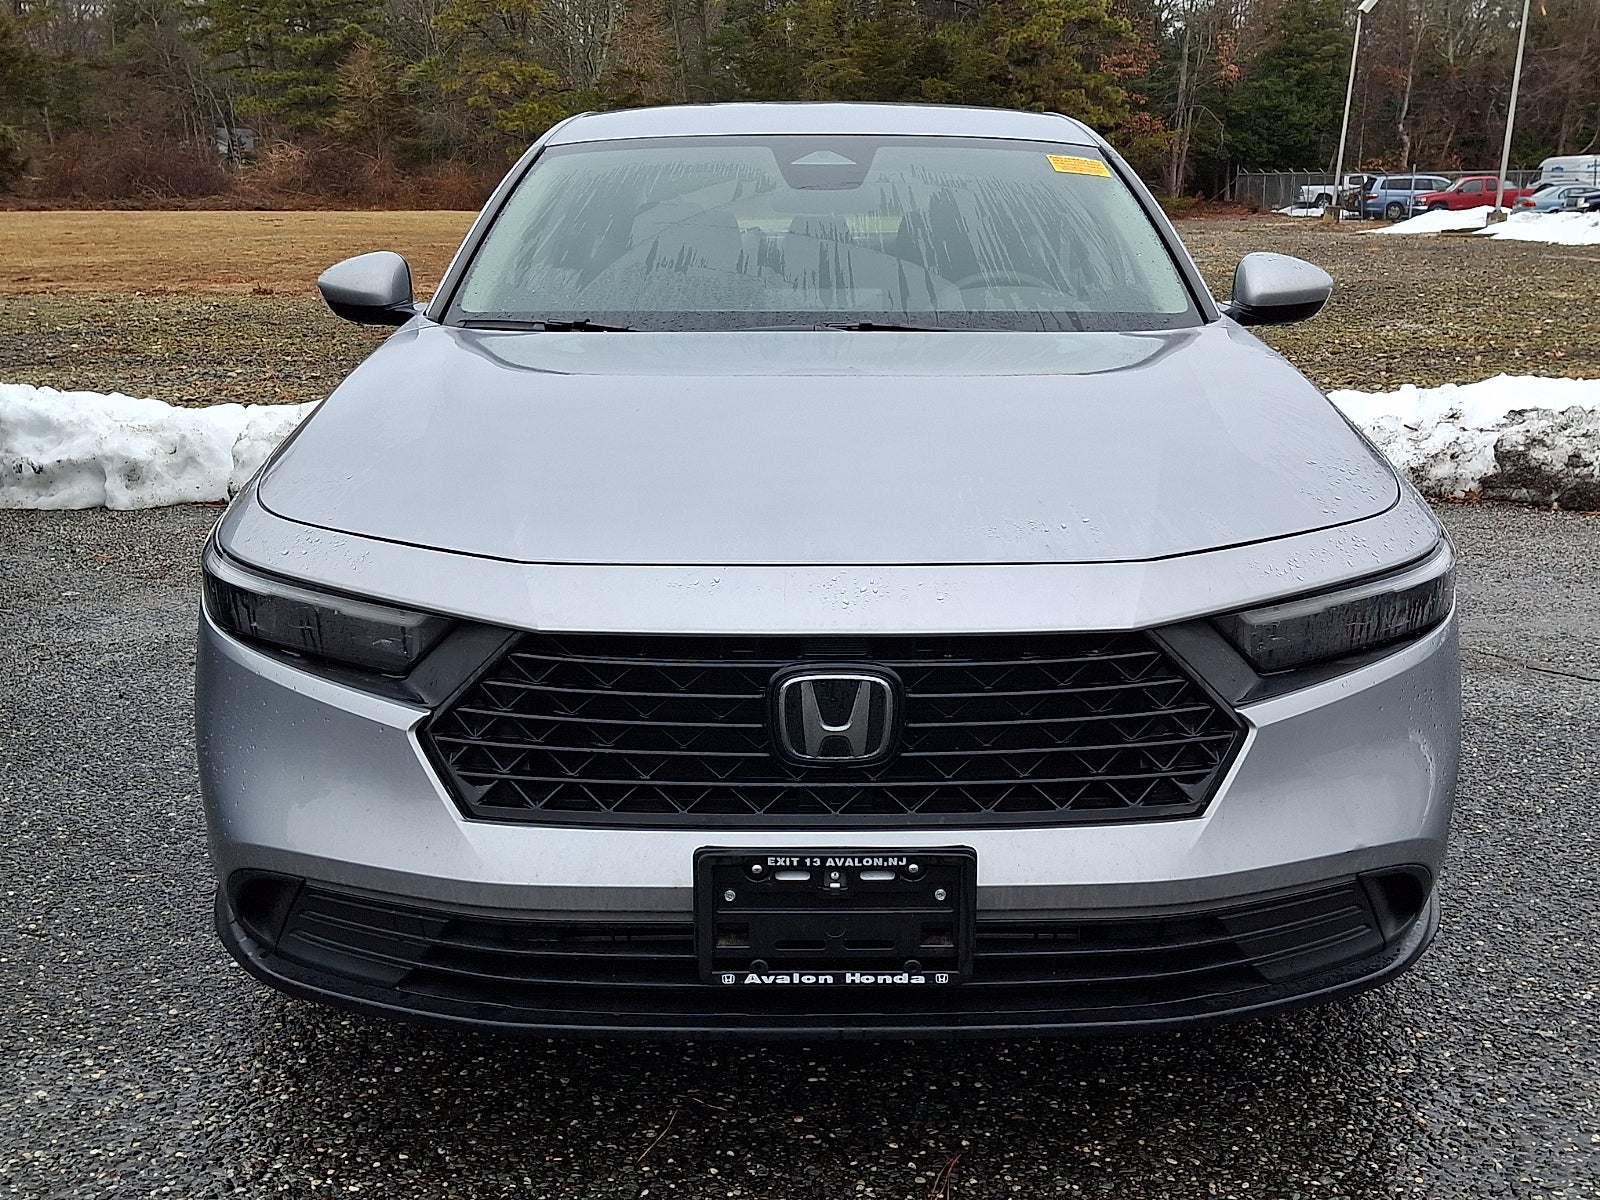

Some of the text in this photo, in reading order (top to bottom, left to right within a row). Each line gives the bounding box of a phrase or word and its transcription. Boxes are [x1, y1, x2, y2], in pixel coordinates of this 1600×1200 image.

[767, 856, 800, 867] EXIT
[804, 857, 821, 867] 13
[744, 973, 834, 984] Avalon
[845, 972, 926, 984] Honda
